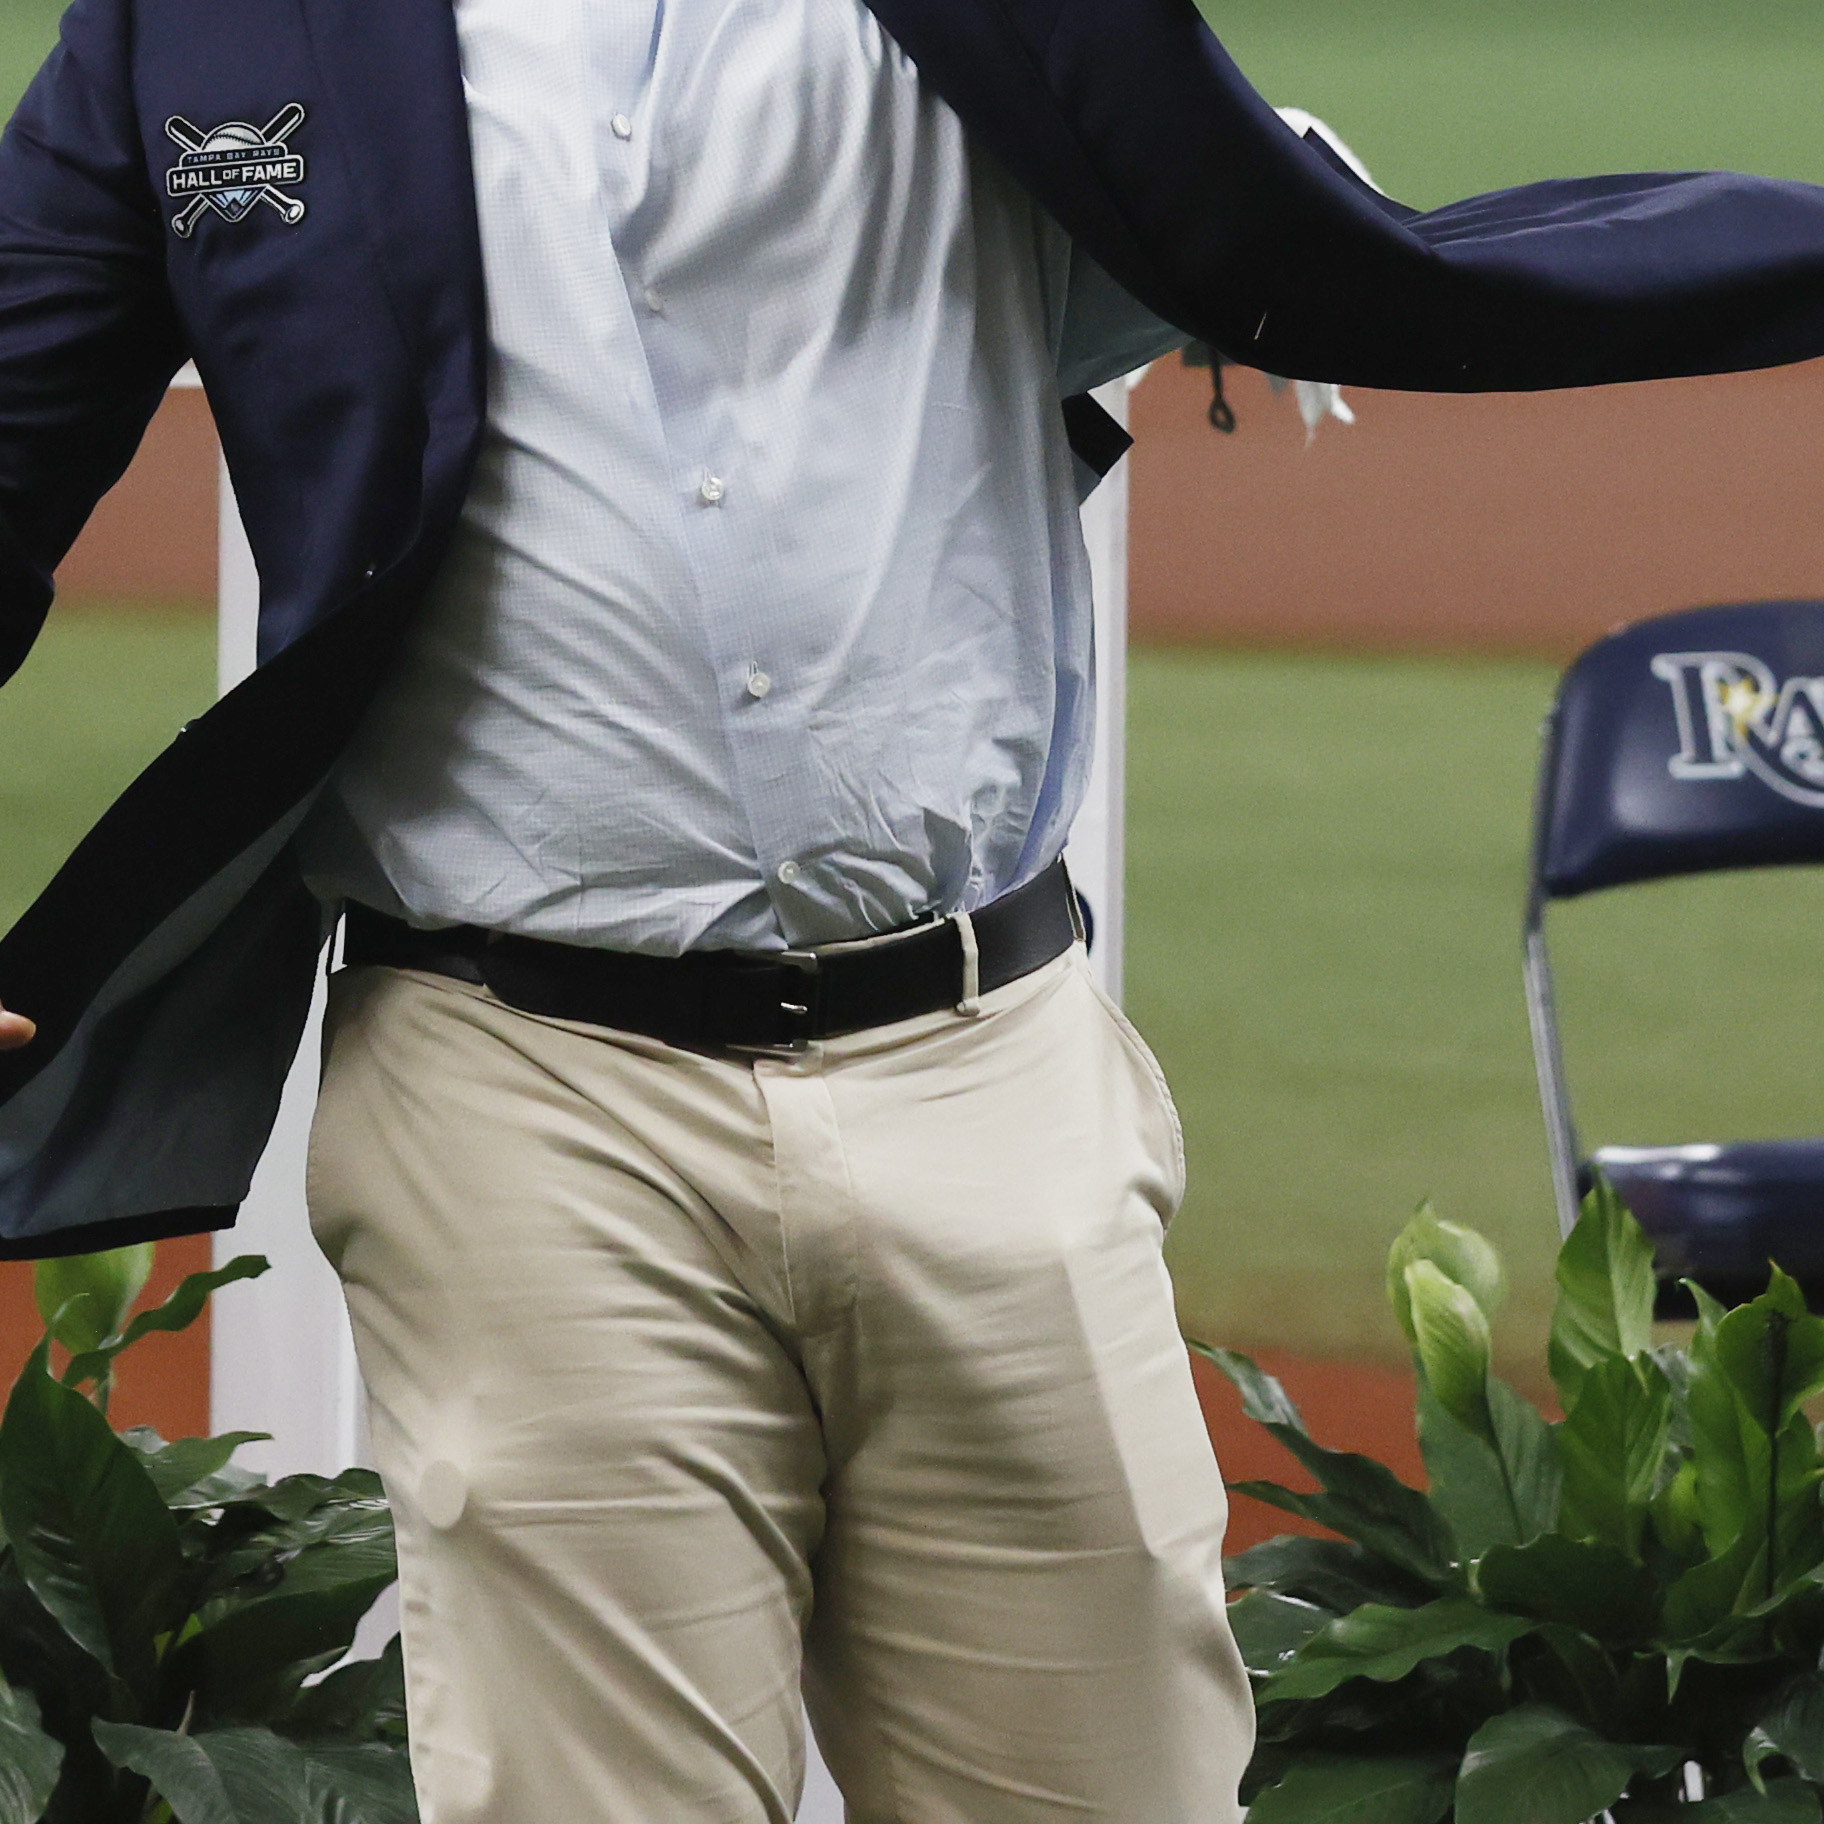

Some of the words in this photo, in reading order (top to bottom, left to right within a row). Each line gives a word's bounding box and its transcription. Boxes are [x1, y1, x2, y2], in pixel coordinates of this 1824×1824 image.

[187, 154, 222, 163] TAMPA
[226, 152, 246, 160] BAY
[253, 148, 280, 157] RAYS
[173, 169, 222, 190] HALL
[223, 169, 239, 180] OF
[242, 162, 297, 182] FAME
